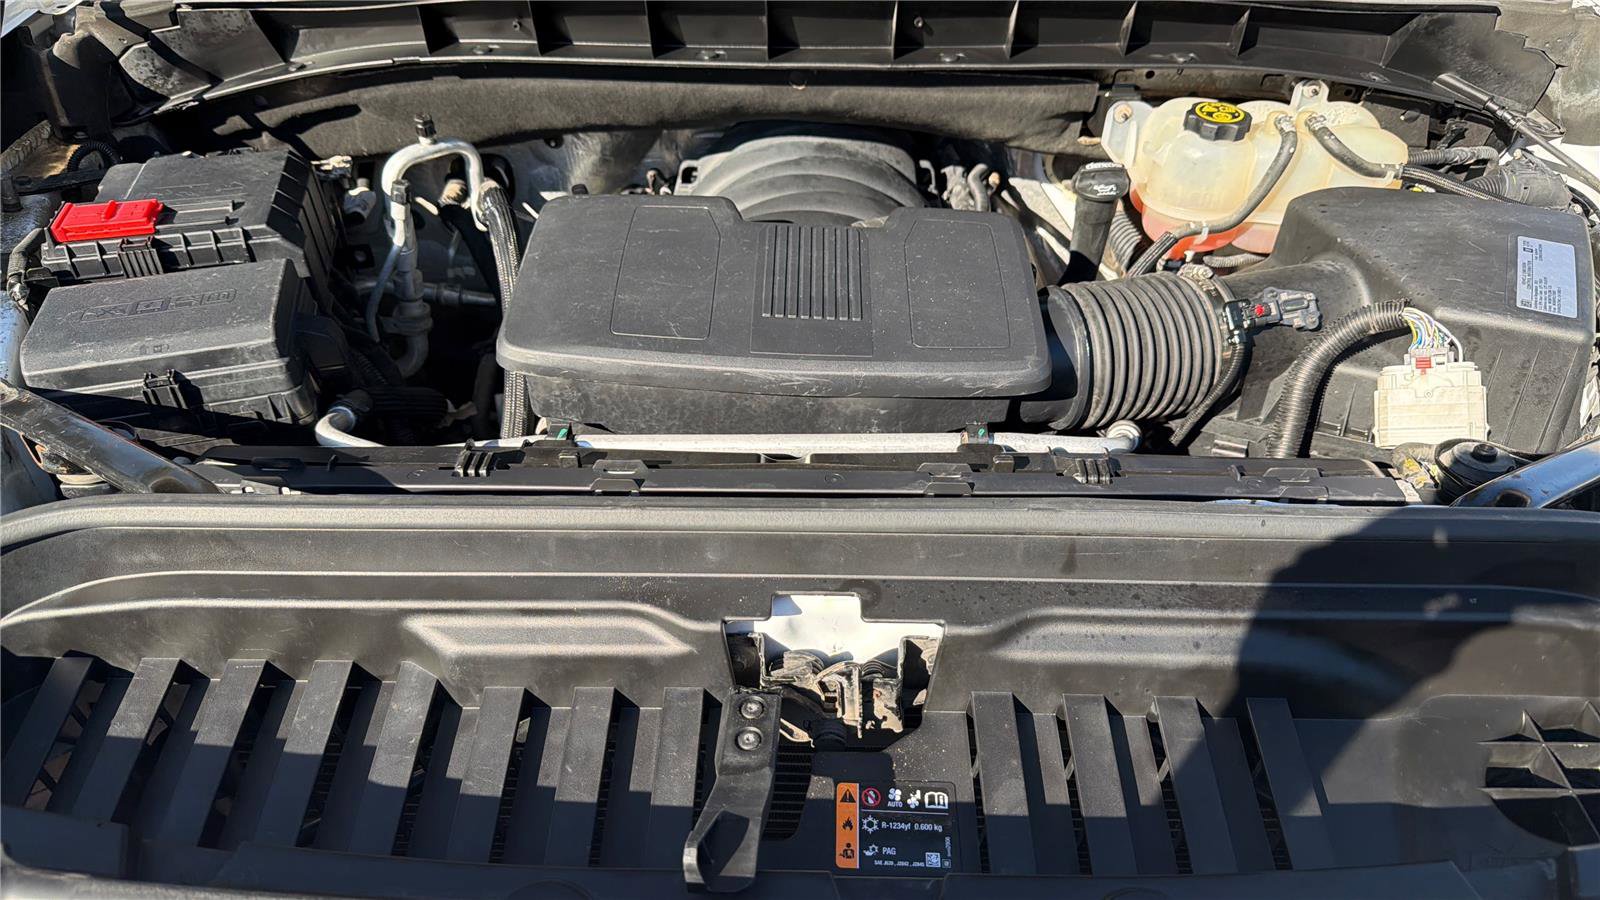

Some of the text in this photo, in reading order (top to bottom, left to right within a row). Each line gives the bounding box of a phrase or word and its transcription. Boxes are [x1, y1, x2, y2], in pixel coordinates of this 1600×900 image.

[881, 821, 943, 832] R-1234yf 0.600 kg
[882, 847, 896, 855] PAG
